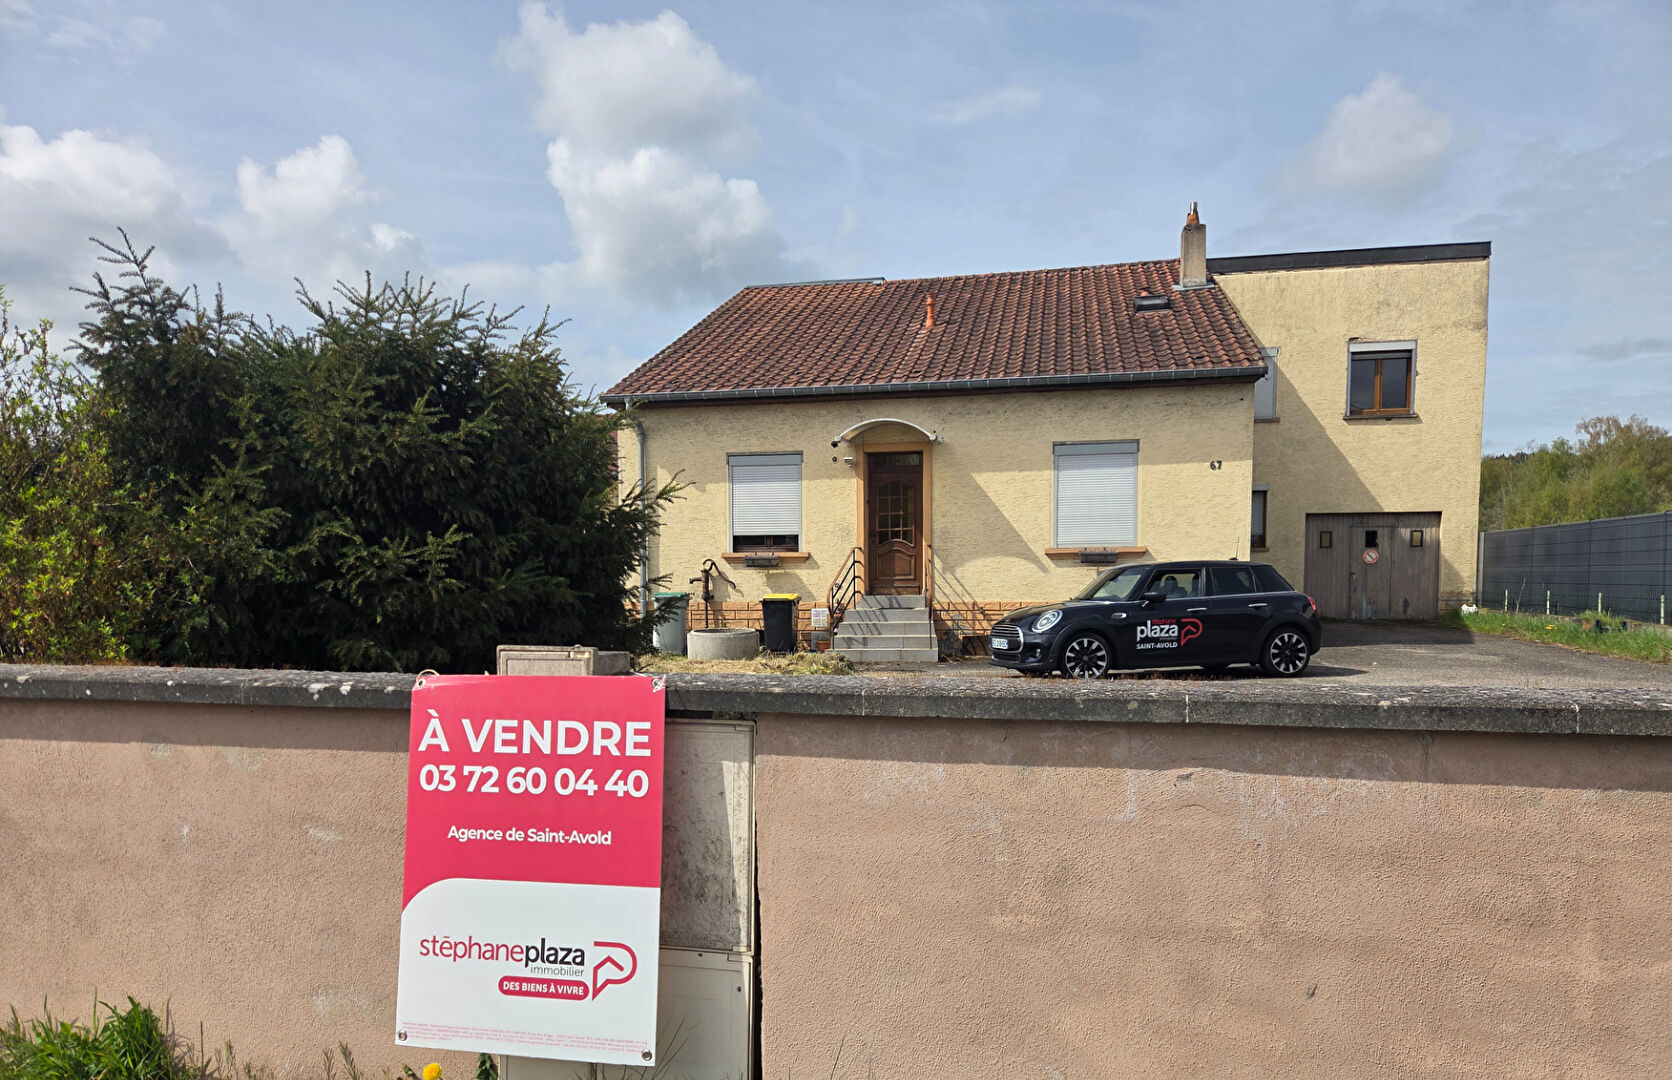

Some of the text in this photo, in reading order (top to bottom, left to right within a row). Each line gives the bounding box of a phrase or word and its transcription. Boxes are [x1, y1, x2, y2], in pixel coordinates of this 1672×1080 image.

[1209, 460, 1223, 471] 67
[1136, 620, 1179, 642] plaza
[1136, 642, 1178, 650] SAINT-AVOLD
[418, 709, 651, 757] À VENDRE
[419, 764, 650, 798] 03 72 60 04 40
[447, 825, 612, 846] Agence de Saint-Avold
[530, 965, 585, 977] immobilier
[503, 981, 585, 996] DES BIENS À VIVRE
